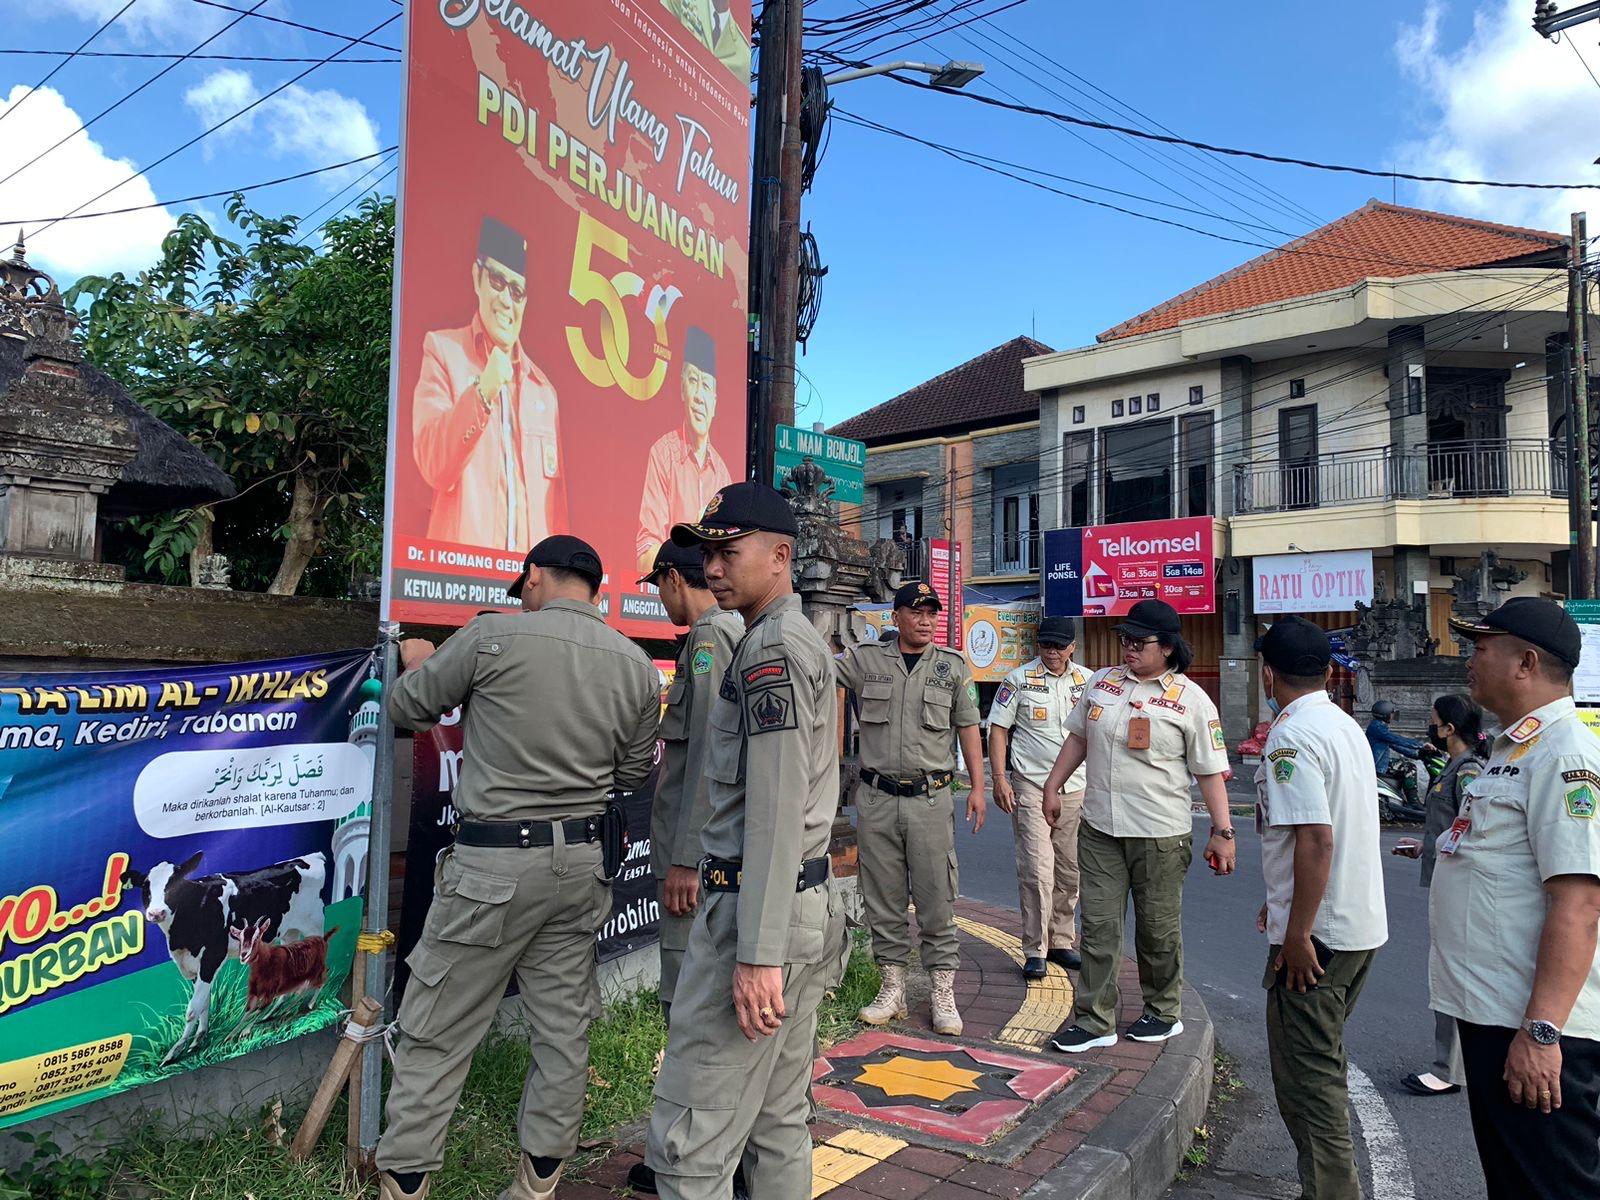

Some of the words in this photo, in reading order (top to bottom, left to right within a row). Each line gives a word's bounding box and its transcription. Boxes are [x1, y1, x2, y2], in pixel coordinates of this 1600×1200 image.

[633, 12, 673, 58] Indonesia
[675, 54, 697, 79] untuk
[698, 72, 733, 111] Indonesia
[439, 0, 588, 79] Selamat
[585, 46, 669, 162] Ulang
[675, 113, 739, 204] Tahun
[477, 72, 537, 156] PDI
[548, 121, 725, 279] PERJUANGAN
[779, 429, 795, 451] JL.
[797, 431, 823, 456] IMAM
[1098, 531, 1201, 558] Telkomsel
[408, 546, 425, 561] Dr.
[430, 552, 434, 562] I
[438, 551, 493, 570] KOMANG
[1054, 562, 1071, 571] LIFE
[1048, 571, 1078, 580] PONSEL
[1121, 570, 1136, 579] 3GB
[1138, 569, 1157, 578] 35GB
[1165, 568, 1180, 577] 5GB
[1183, 567, 1203, 576] 14GB
[1259, 573, 1302, 600] RATU
[1311, 569, 1368, 599] OPTIK
[404, 578, 442, 598] KETUA
[445, 583, 467, 600] DPC
[469, 585, 486, 603] PDI
[1119, 590, 1138, 598] 2.5GB
[1164, 585, 1183, 593] 30GB
[623, 599, 660, 616] ANGGOTA
[997, 610, 1020, 625] Evelyn
[226, 668, 329, 704] IKHLAS
[1151, 699, 1169, 708] POL
[1172, 703, 1184, 712] PP
[74, 712, 170, 746] Kediri,
[178, 710, 297, 735] Tabanan
[1502, 765, 1520, 777] PP
[162, 802, 188, 813] Maka
[189, 797, 231, 810] dirikanlah
[233, 793, 262, 804] shalat
[264, 791, 297, 802] karena
[340, 786, 355, 796] dan
[195, 807, 257, 822] berkorbanlah.
[260, 803, 310, 817] [Al-Kautsar
[624, 866, 645, 881] EASY
[0, 915, 138, 1005] URBAN
[44, 1054, 68, 1068] 0815
[71, 1046, 97, 1061] 5867
[98, 1039, 123, 1053] 8588
[40, 1067, 67, 1081] 0852
[69, 1060, 93, 1074] 3745
[96, 1052, 122, 1066] 4008
[36, 1080, 62, 1093] 0817
[62, 1074, 82, 1086] 350
[84, 1068, 103, 1080] 478
